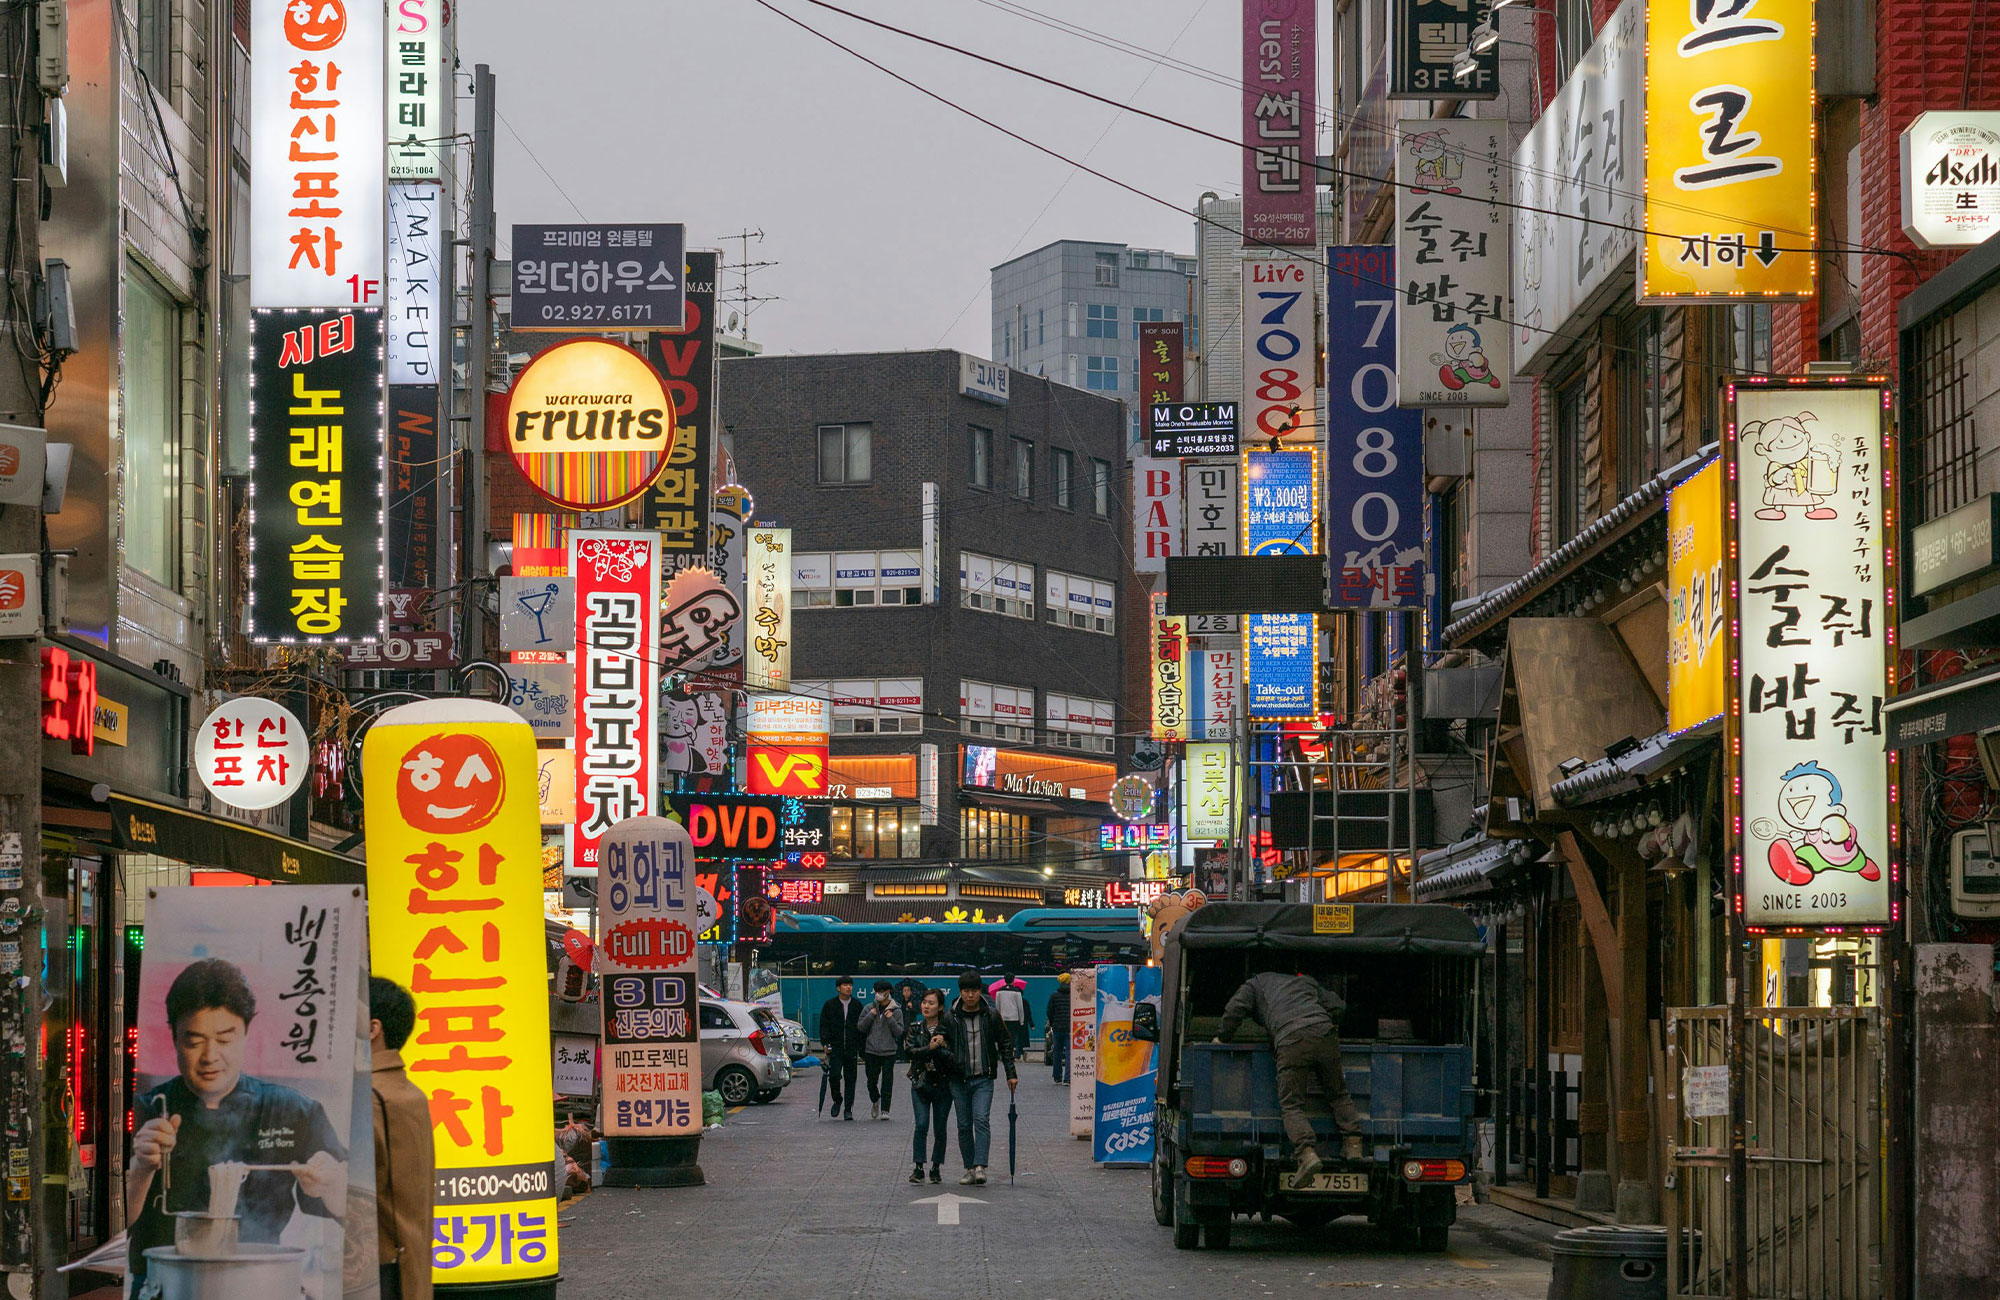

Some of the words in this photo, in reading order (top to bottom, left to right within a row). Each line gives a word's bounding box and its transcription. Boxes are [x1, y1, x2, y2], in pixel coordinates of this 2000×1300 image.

[399, 42, 427, 157] 필라테스
[288, 60, 343, 277] 한신포차
[391, 165, 435, 176] 6215-1004
[1926, 153, 2000, 185] Asah
[1956, 192, 1978, 209] 生
[543, 231, 601, 247] 프리미엄
[607, 230, 653, 247] 원룸텔
[1248, 228, 1310, 240] T.921-2167
[1680, 234, 1746, 268] 지하
[346, 274, 380, 304] 1F
[517, 260, 677, 295] 원더하우스
[1253, 265, 1305, 283] Live
[541, 305, 652, 321] 02.927.6171
[278, 315, 355, 369] 시티
[1256, 291, 1302, 435] 7080
[545, 393, 633, 406] warawara
[1419, 391, 1443, 400] SINCE
[1447, 391, 1468, 399] 2003
[515, 408, 664, 442] Fruits
[1351, 300, 1400, 542] 7080
[1155, 439, 1171, 452] 4F
[289, 373, 347, 635] 노래연습장
[1145, 470, 1171, 558] BAR
[1852, 436, 1872, 582] 퓨전민속주점
[754, 519, 777, 528] emart
[1950, 518, 1990, 556] 1661-3392
[1339, 566, 1416, 600] 콘서트
[518, 652, 537, 661] DIY
[1158, 619, 1184, 728] 노래연습장
[1210, 651, 1236, 727] 만선참치
[1256, 684, 1305, 695] Take-out
[588, 597, 640, 833] 꼼보포차
[753, 700, 824, 715] 피부관리샵
[212, 716, 289, 750] 한신
[529, 719, 561, 729] &Dining
[1208, 727, 1238, 738] 전문
[212, 754, 290, 786] 포차
[754, 754, 823, 789] VR
[1004, 773, 1023, 793] Ma
[1201, 750, 1229, 816] 더풋샵
[689, 803, 776, 850] DVD
[785, 828, 823, 846] 연습장
[787, 852, 801, 863] 4F
[607, 840, 686, 912] 영화관
[1186, 893, 1204, 909] 3F
[1762, 893, 1802, 911] SINCE
[1811, 892, 1848, 909] 2003
[612, 931, 650, 957] Full
[660, 931, 688, 956] HD
[279, 905, 327, 1063] 백종원
[403, 842, 514, 1158] 한신포차
[615, 1009, 687, 1039] 진동의자
[557, 1045, 591, 1066] 京城
[614, 1048, 689, 1069] HD프로젝터
[556, 1074, 589, 1082] IZAKAYA
[616, 1098, 691, 1128] 흡연가능
[1322, 1175, 1359, 1190] 7551
